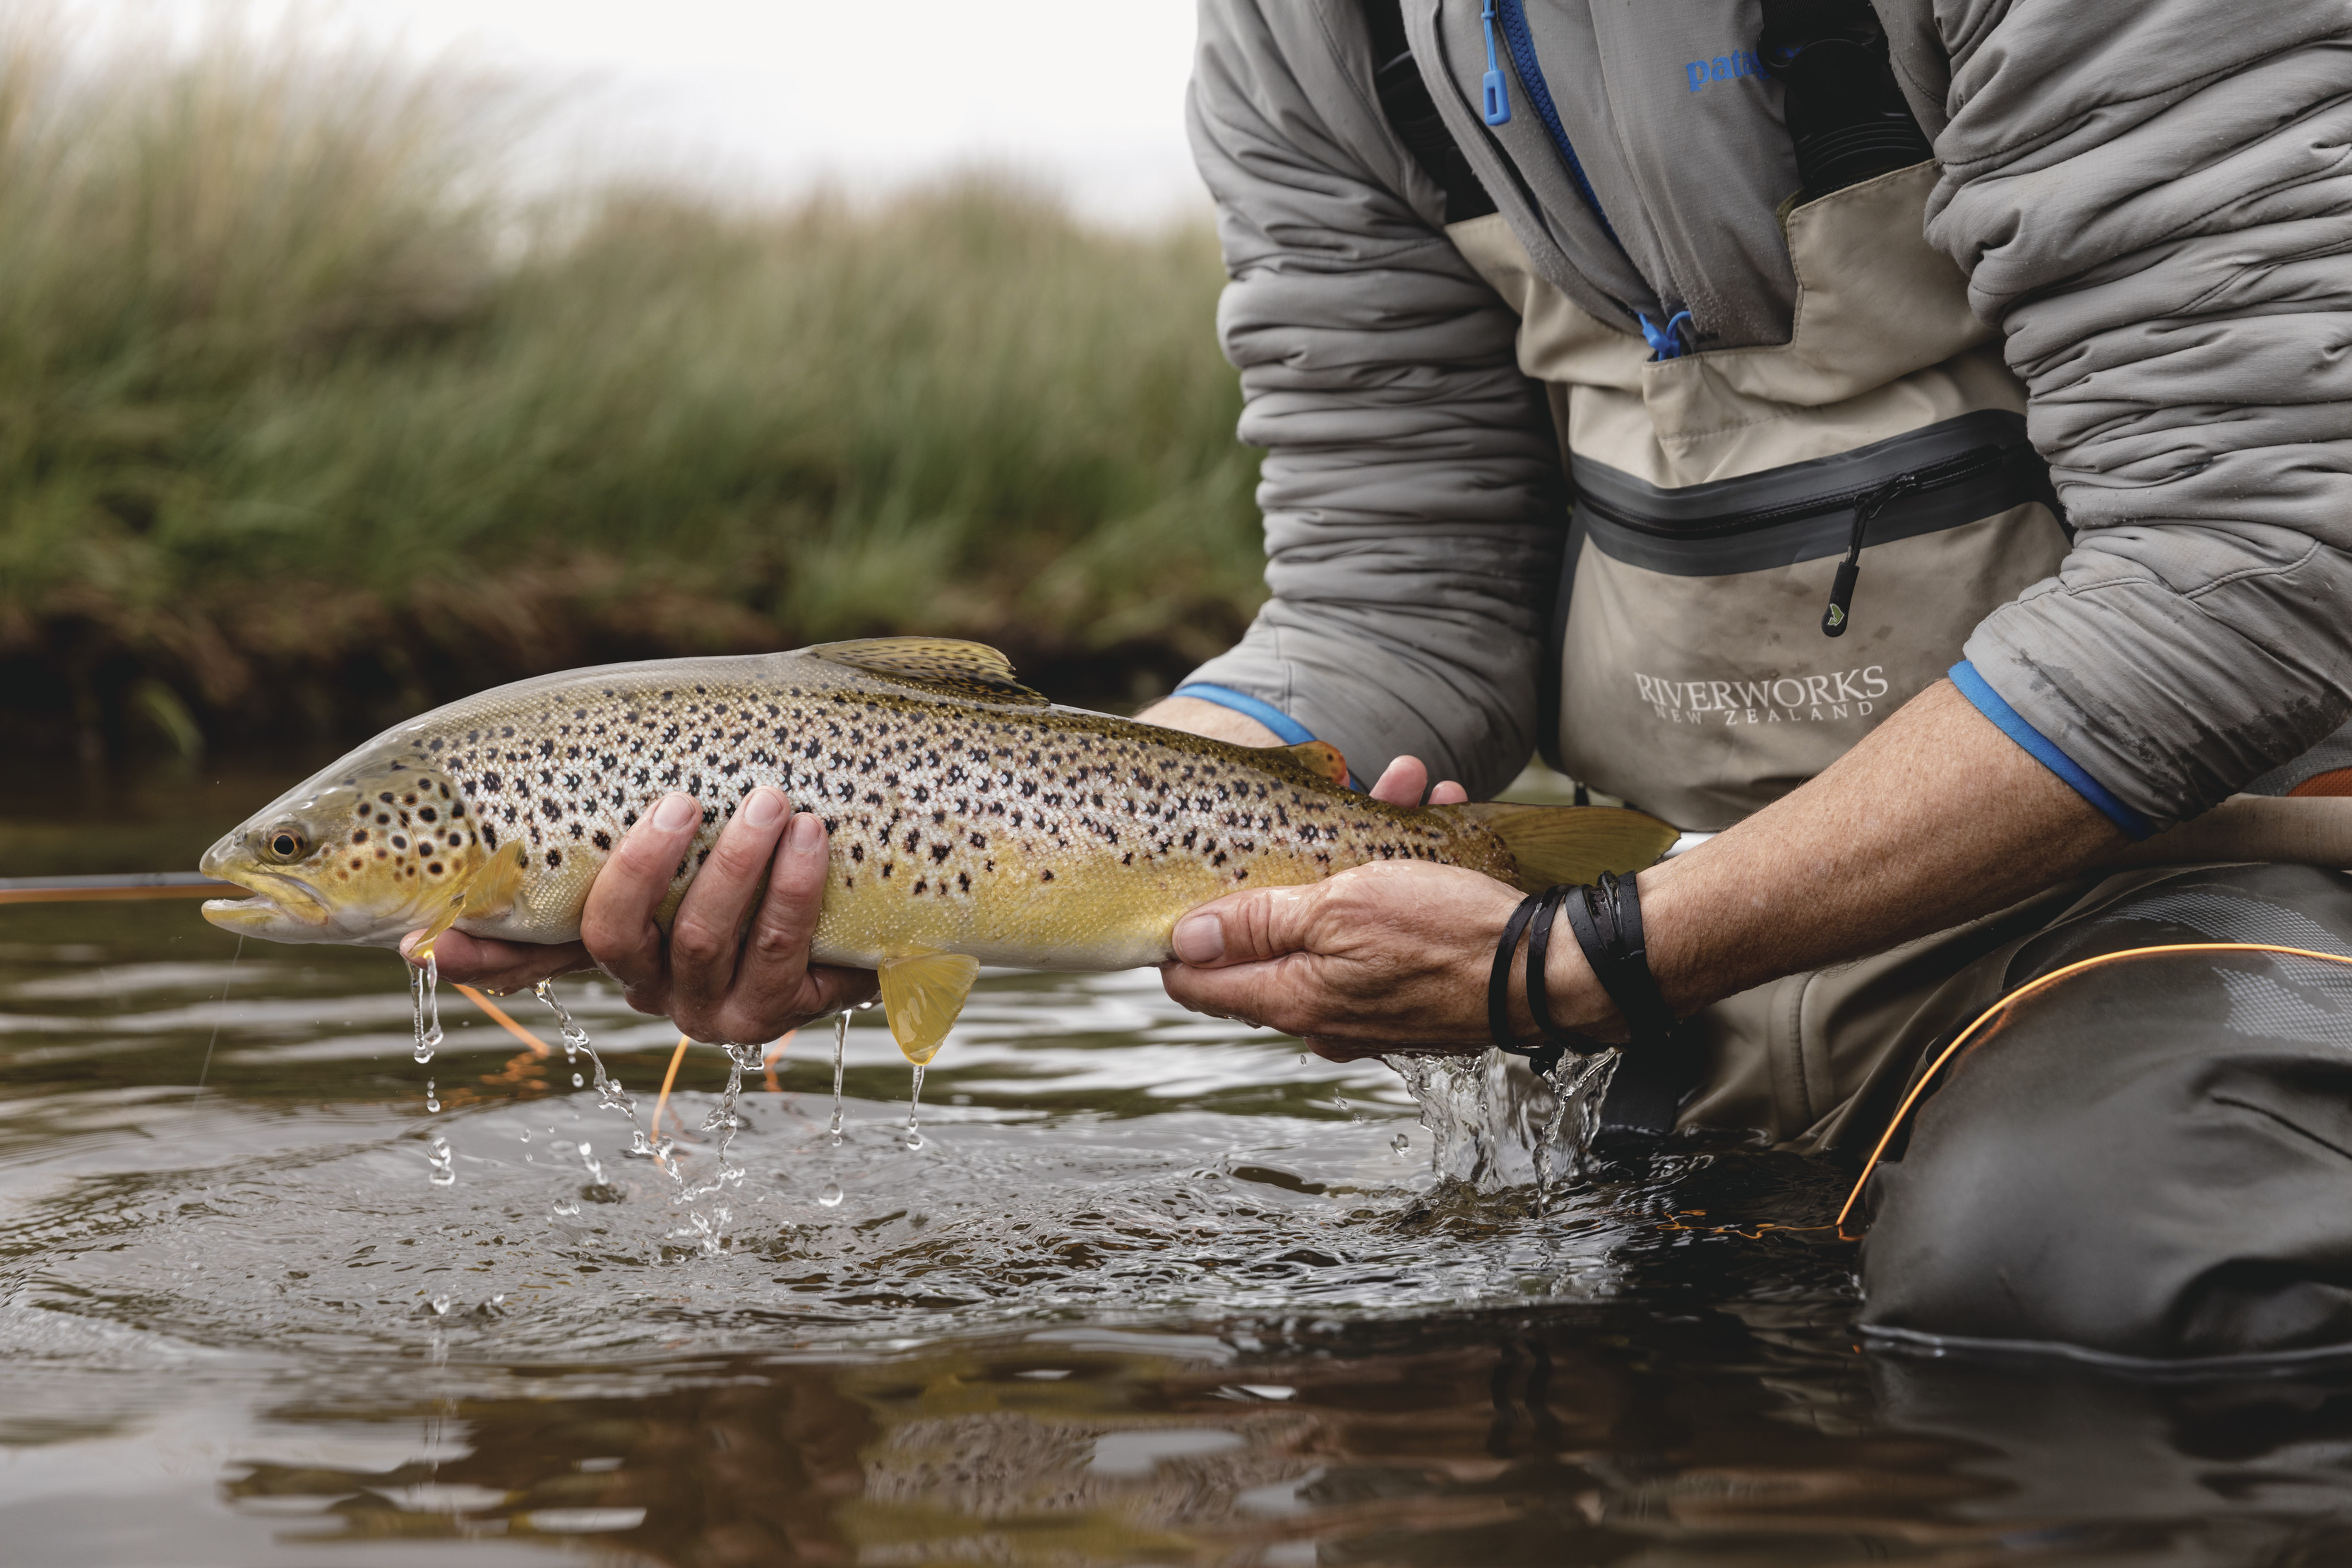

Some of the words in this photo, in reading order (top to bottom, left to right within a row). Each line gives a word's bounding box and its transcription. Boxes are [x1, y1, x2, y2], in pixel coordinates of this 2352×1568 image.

[1634, 665, 1889, 712] RIVERWORKS
[1654, 703, 1702, 725] NEW
[1725, 700, 1873, 726] ZEALAND
